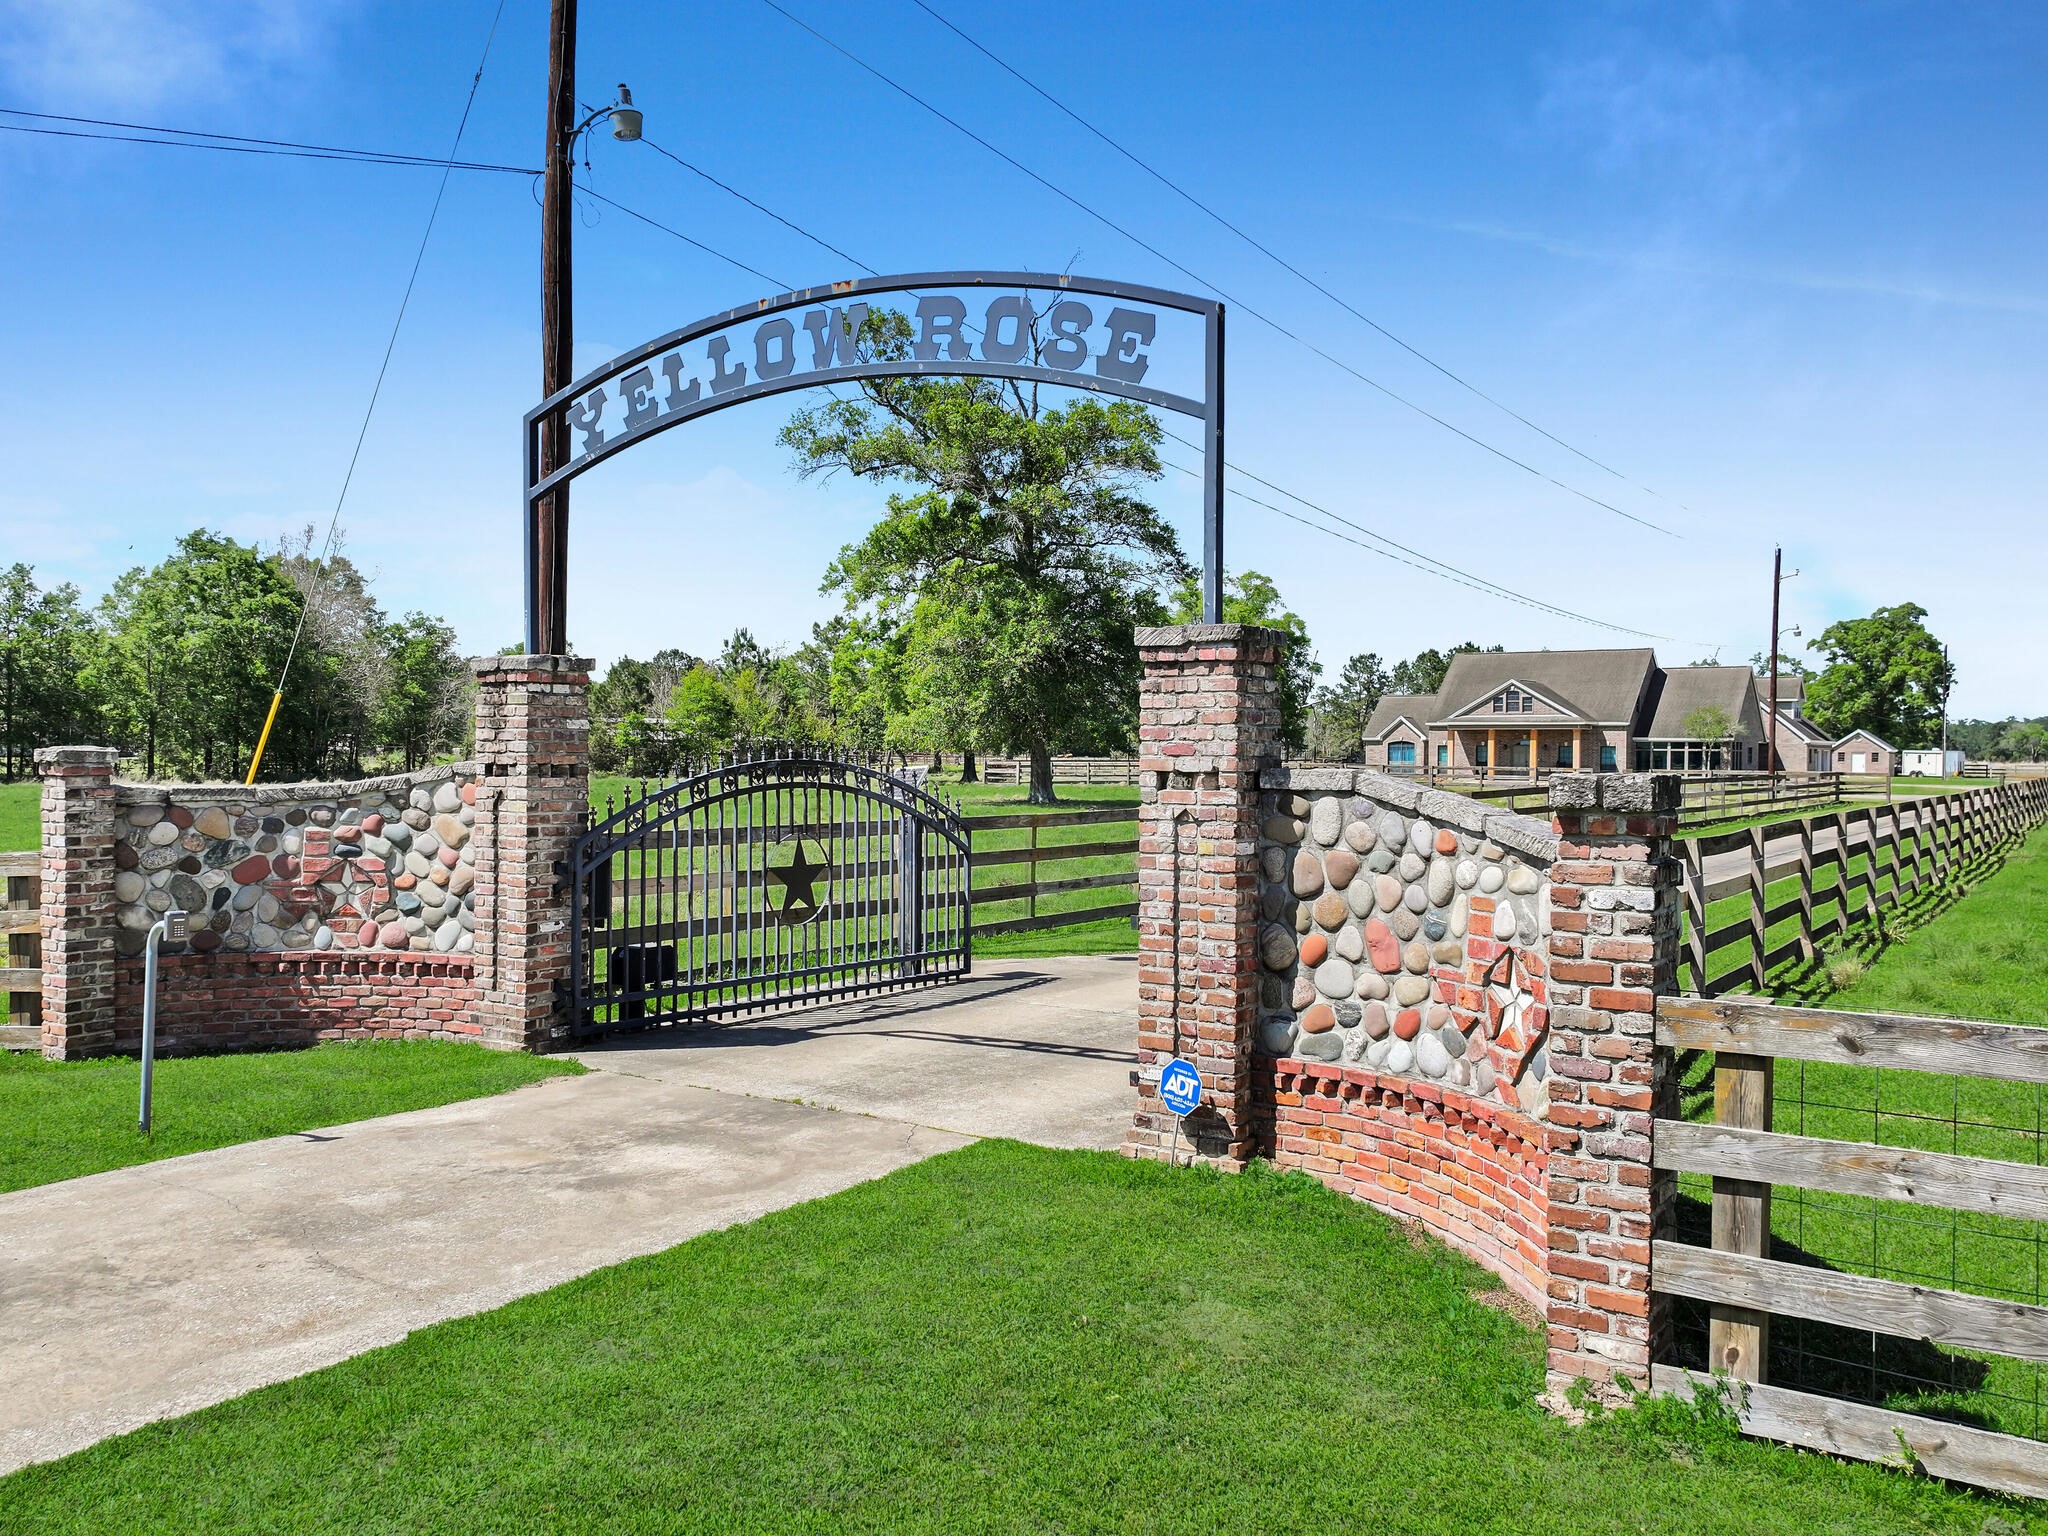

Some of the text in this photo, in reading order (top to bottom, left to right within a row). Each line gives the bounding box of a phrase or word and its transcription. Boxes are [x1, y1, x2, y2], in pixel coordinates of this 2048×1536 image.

[566, 296, 1155, 452] YELLOW ROSE
[1164, 1073, 1198, 1099] ADT
